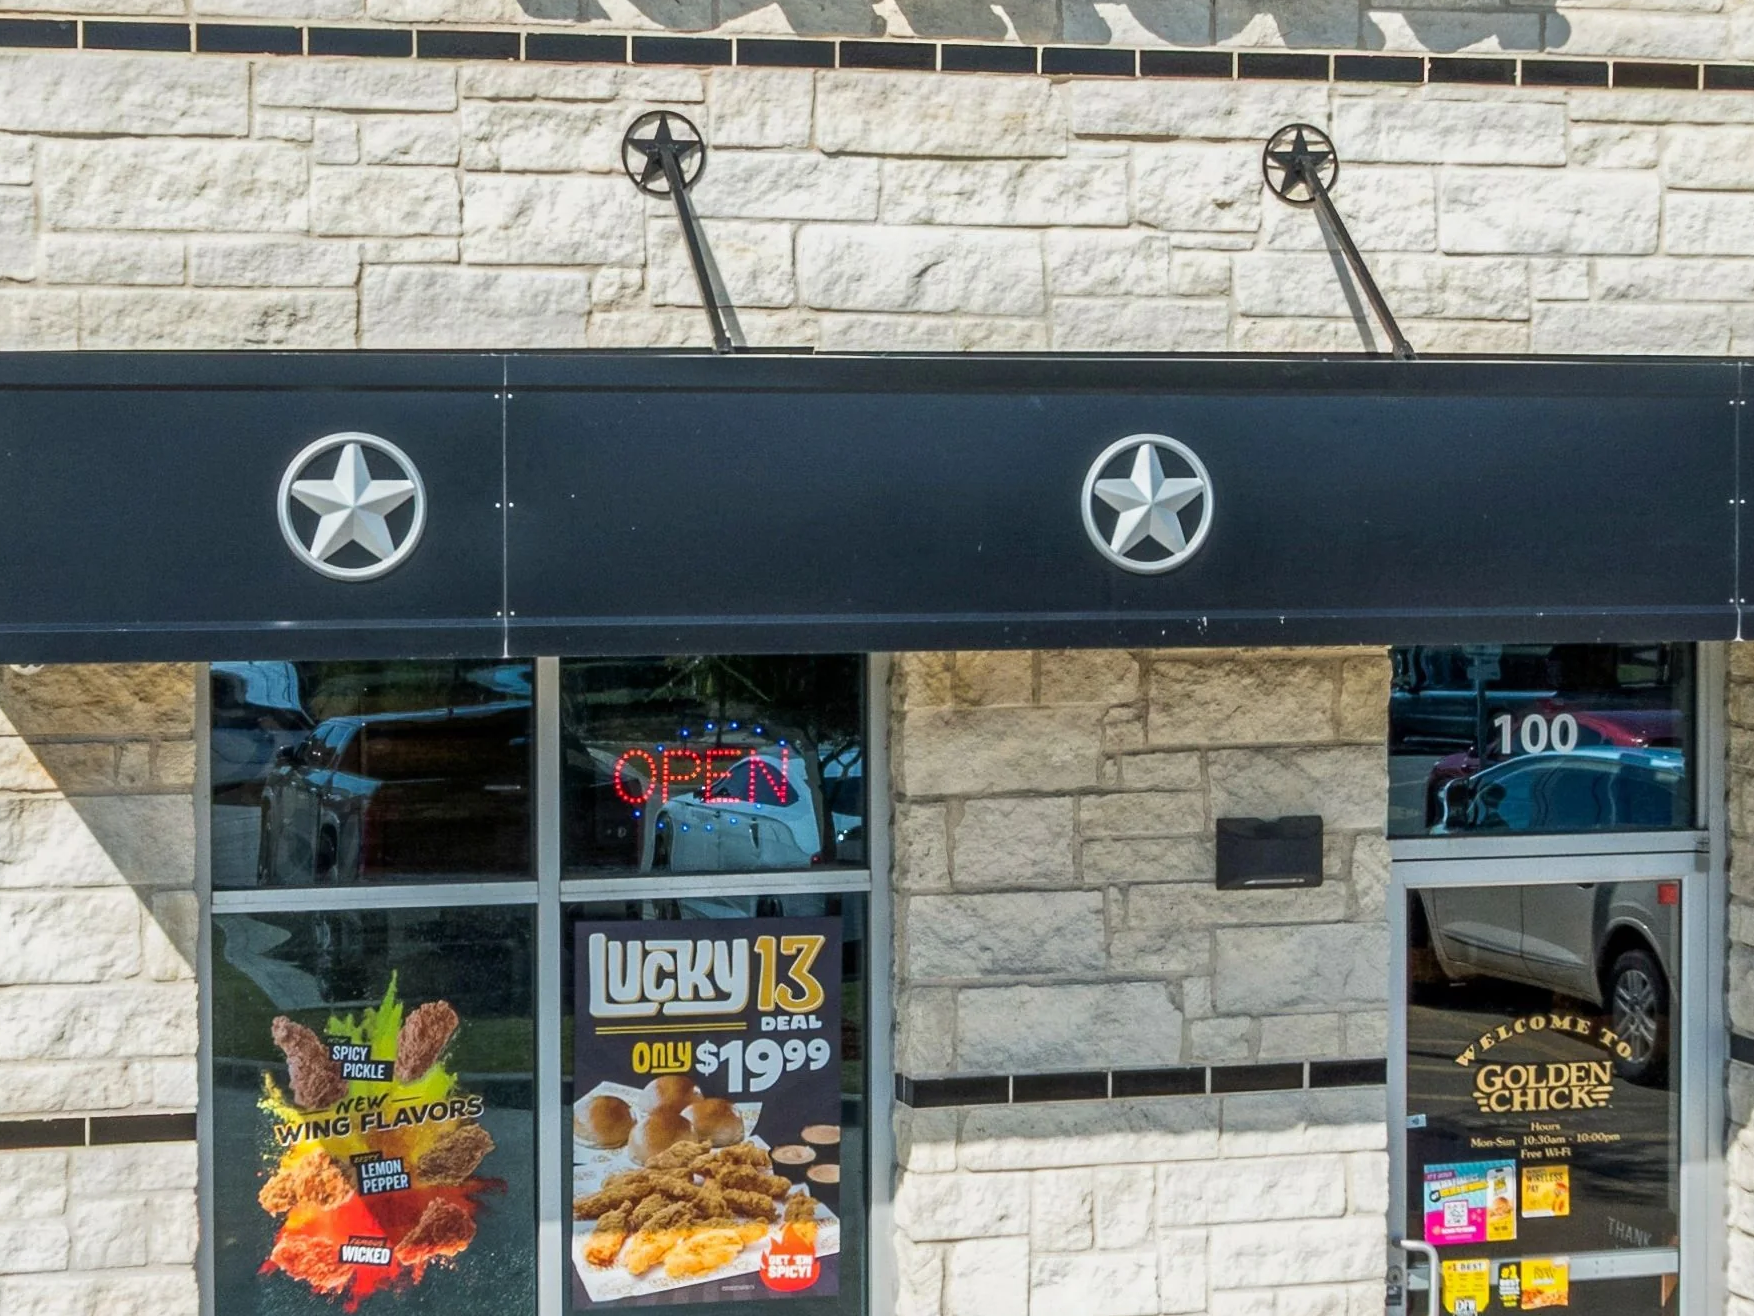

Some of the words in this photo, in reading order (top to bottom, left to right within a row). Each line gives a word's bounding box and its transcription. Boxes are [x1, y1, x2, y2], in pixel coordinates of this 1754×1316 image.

[1494, 713, 1578, 755] 100
[613, 748, 790, 805] OPEN
[589, 933, 750, 1018] LUCKY
[753, 935, 826, 1013] 13
[761, 1015, 823, 1032] DEAL
[1455, 1014, 1592, 1067] WELCOME
[1599, 1027, 1632, 1060] TO
[332, 1045, 368, 1062] SPICY
[343, 1063, 385, 1079] PICKLE
[1476, 1061, 1613, 1094] GOLDEN
[335, 1093, 389, 1115] NEW
[1489, 1086, 1595, 1112] CHICK
[274, 1115, 351, 1147] WING
[360, 1096, 485, 1133] FLAVORS
[1531, 1122, 1561, 1131] Hours
[1470, 1137, 1516, 1148] Mon-Sun
[1523, 1135, 1566, 1146] 10:30am
[1520, 1148, 1542, 1158] Free
[361, 1161, 402, 1178] LEMON
[1526, 1171, 1563, 1183] WIRELESS
[362, 1174, 409, 1194] PEPPER
[341, 1245, 391, 1264] WICKED
[767, 1265, 813, 1279] SPICY!
